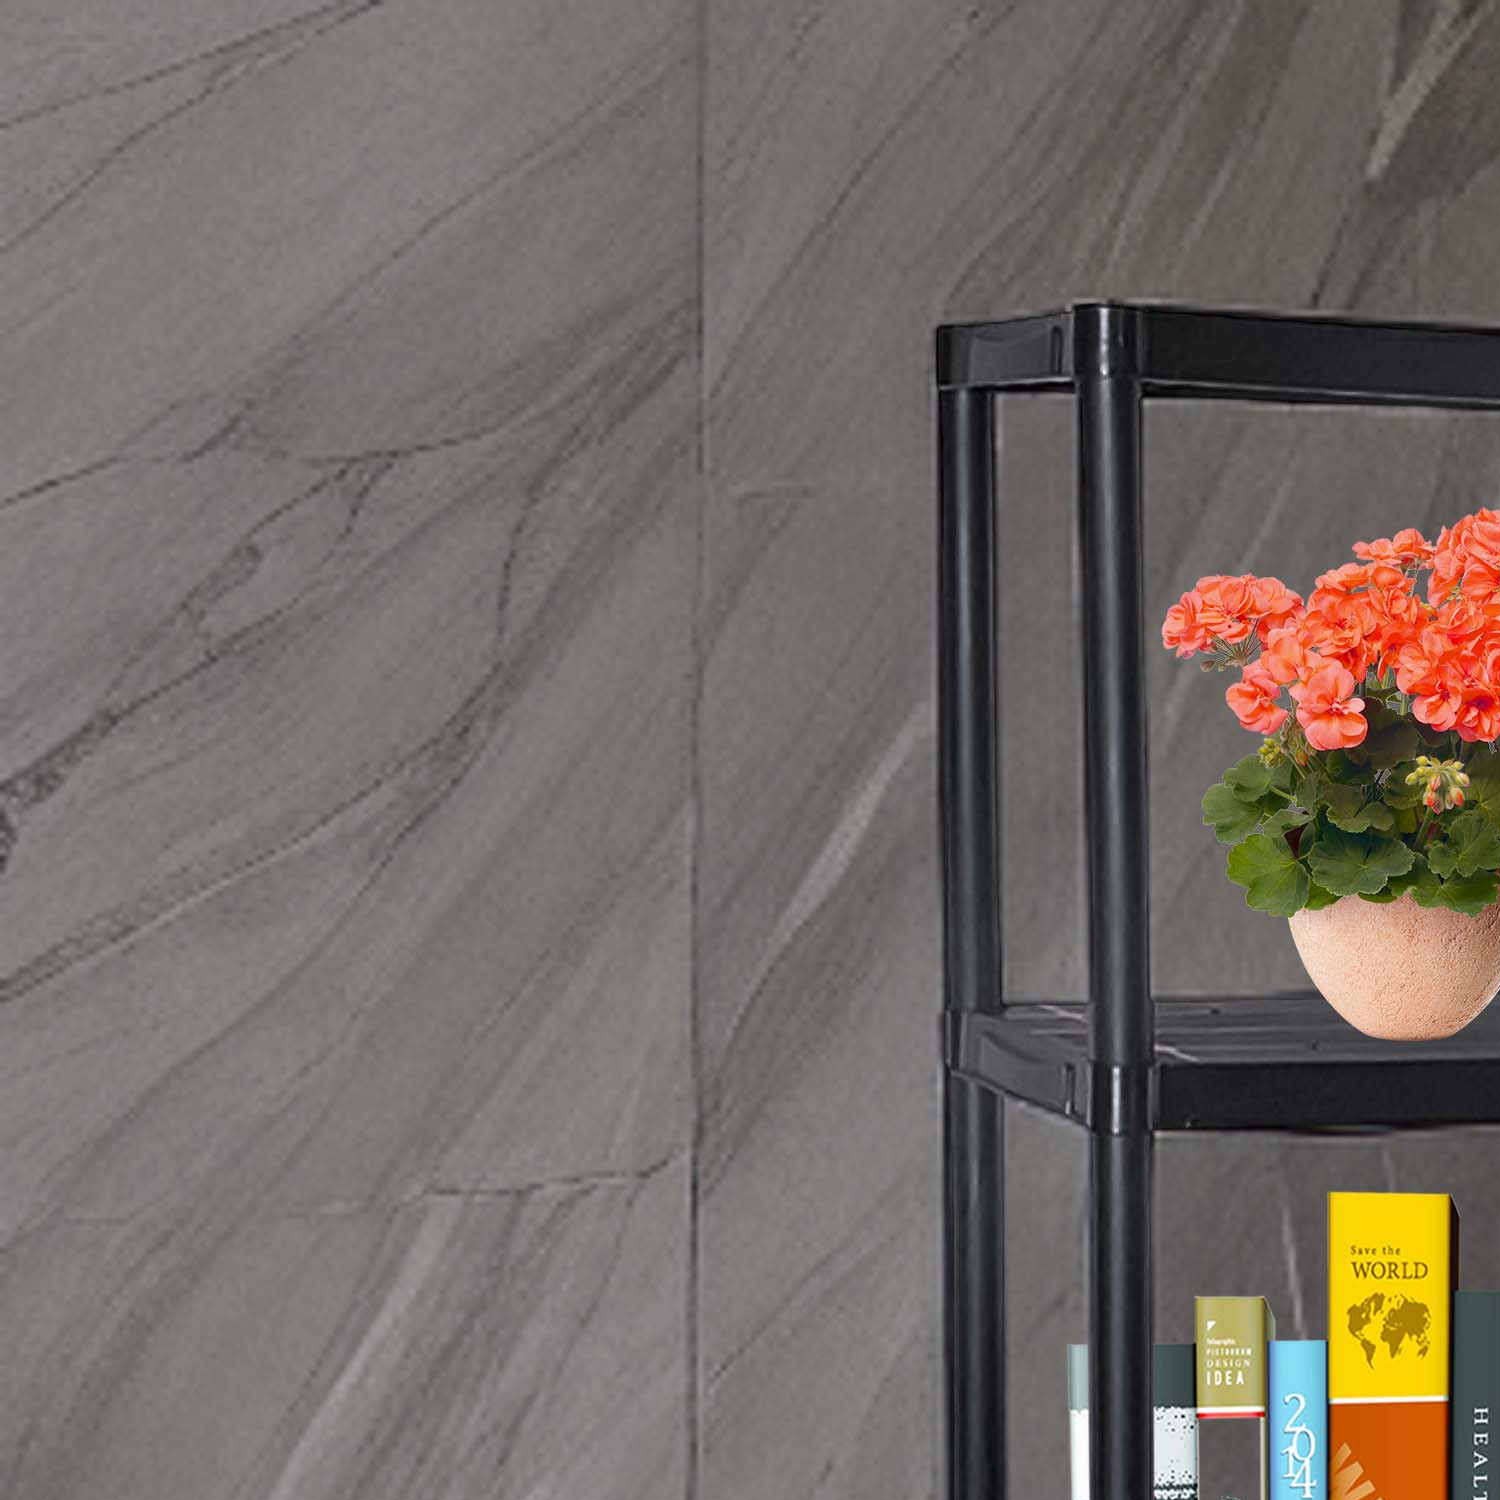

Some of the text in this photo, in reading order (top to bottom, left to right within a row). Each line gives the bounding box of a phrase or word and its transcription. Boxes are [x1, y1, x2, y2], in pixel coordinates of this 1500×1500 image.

[1350, 1244, 1401, 1256] Save the
[1351, 1260, 1429, 1280] WORLD
[1206, 1359, 1251, 1368] DESIGN
[1206, 1370, 1245, 1386] IDEA
[1281, 1393, 1318, 1500] 2014
